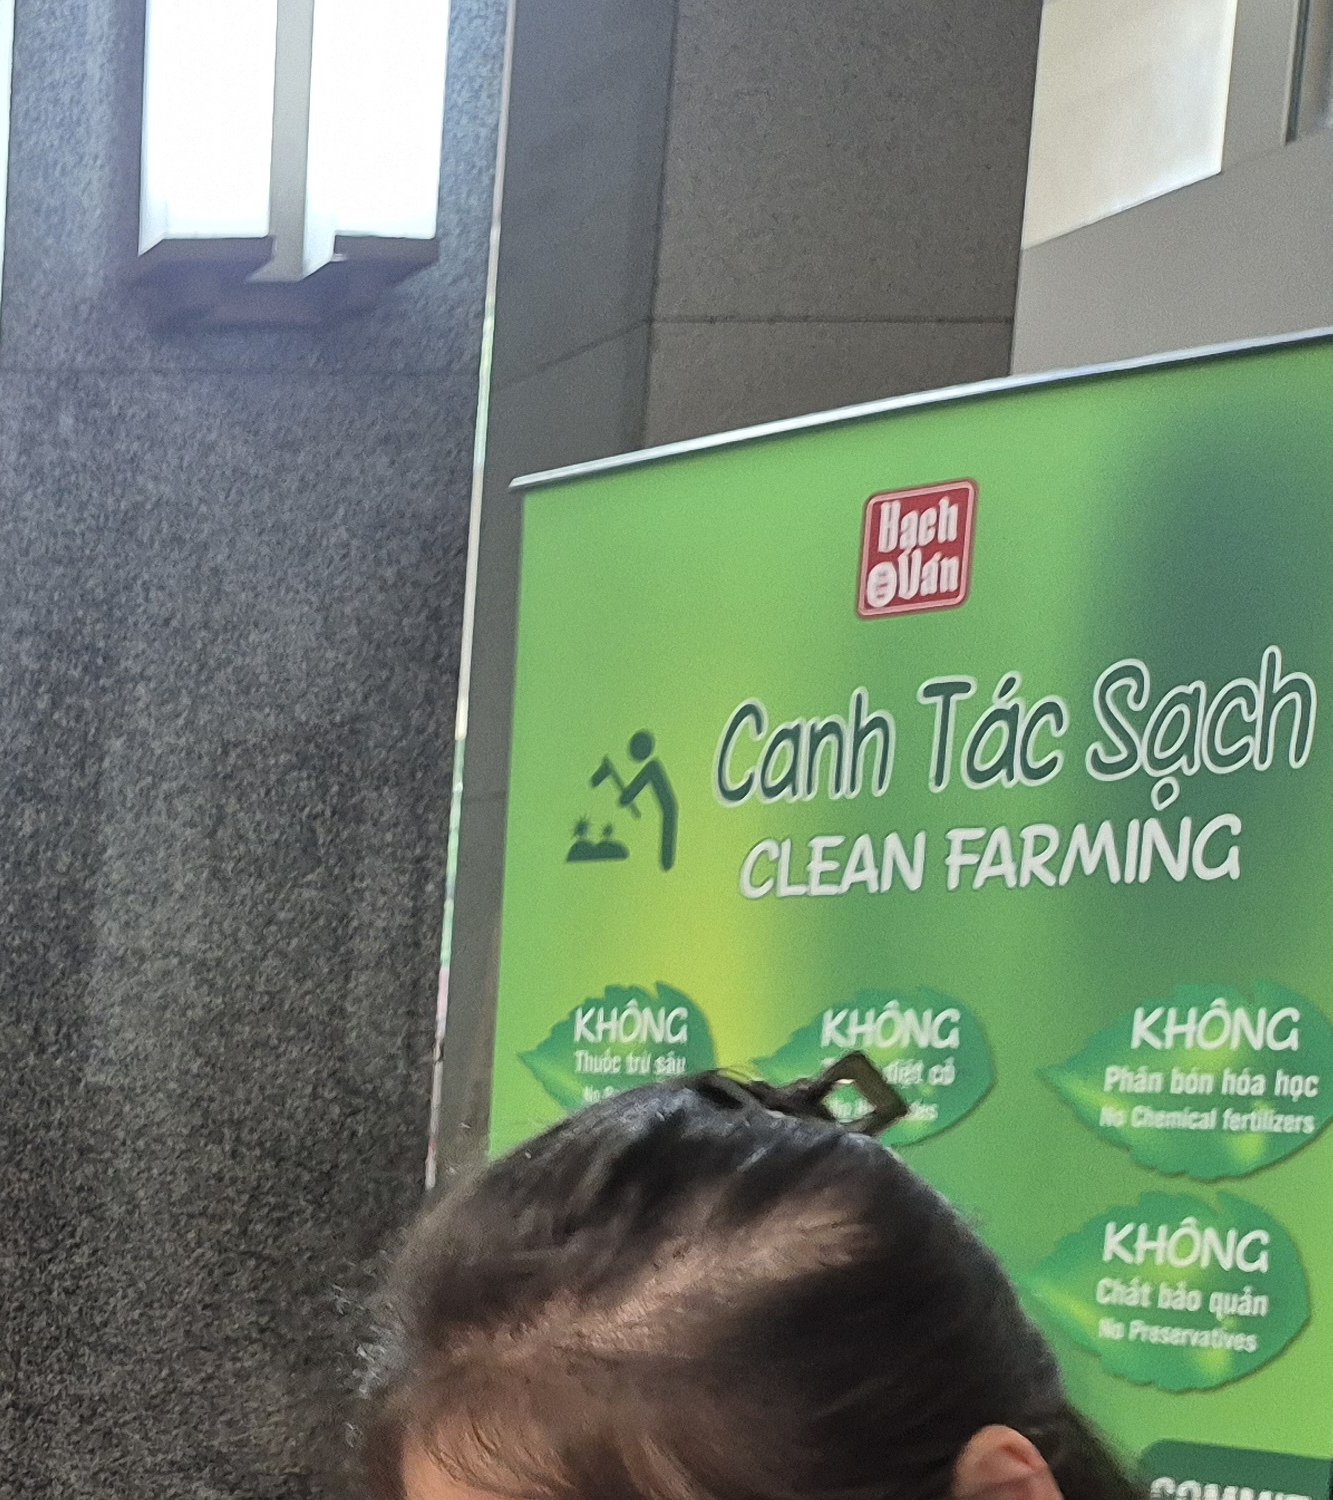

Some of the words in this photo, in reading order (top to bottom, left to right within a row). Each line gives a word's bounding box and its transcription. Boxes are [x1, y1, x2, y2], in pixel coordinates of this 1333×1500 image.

[713, 687, 895, 808] Canh
[918, 670, 1070, 795] Tác
[1086, 645, 1318, 811] Sạch
[740, 830, 927, 901] CLEAN
[945, 813, 1241, 892] FARMING
[574, 999, 688, 1044] KHÔNG
[821, 1001, 961, 1049] KHÔNG
[1131, 998, 1300, 1051] KHÔNG
[575, 1050, 621, 1074] Thuốc
[1170, 1067, 1214, 1094] bón
[1222, 1068, 1266, 1096] hóa
[1274, 1069, 1320, 1102] học
[1100, 1106, 1127, 1127] No
[1131, 1106, 1218, 1130] Chemical
[1223, 1108, 1315, 1134] fertilizers
[1103, 1217, 1270, 1273] KHÔNG
[1096, 1277, 1152, 1308] Chất
[1158, 1281, 1202, 1312] bảo
[1209, 1286, 1269, 1321] quản
[1099, 1318, 1124, 1340] No
[1129, 1320, 1258, 1353] Preservatives
